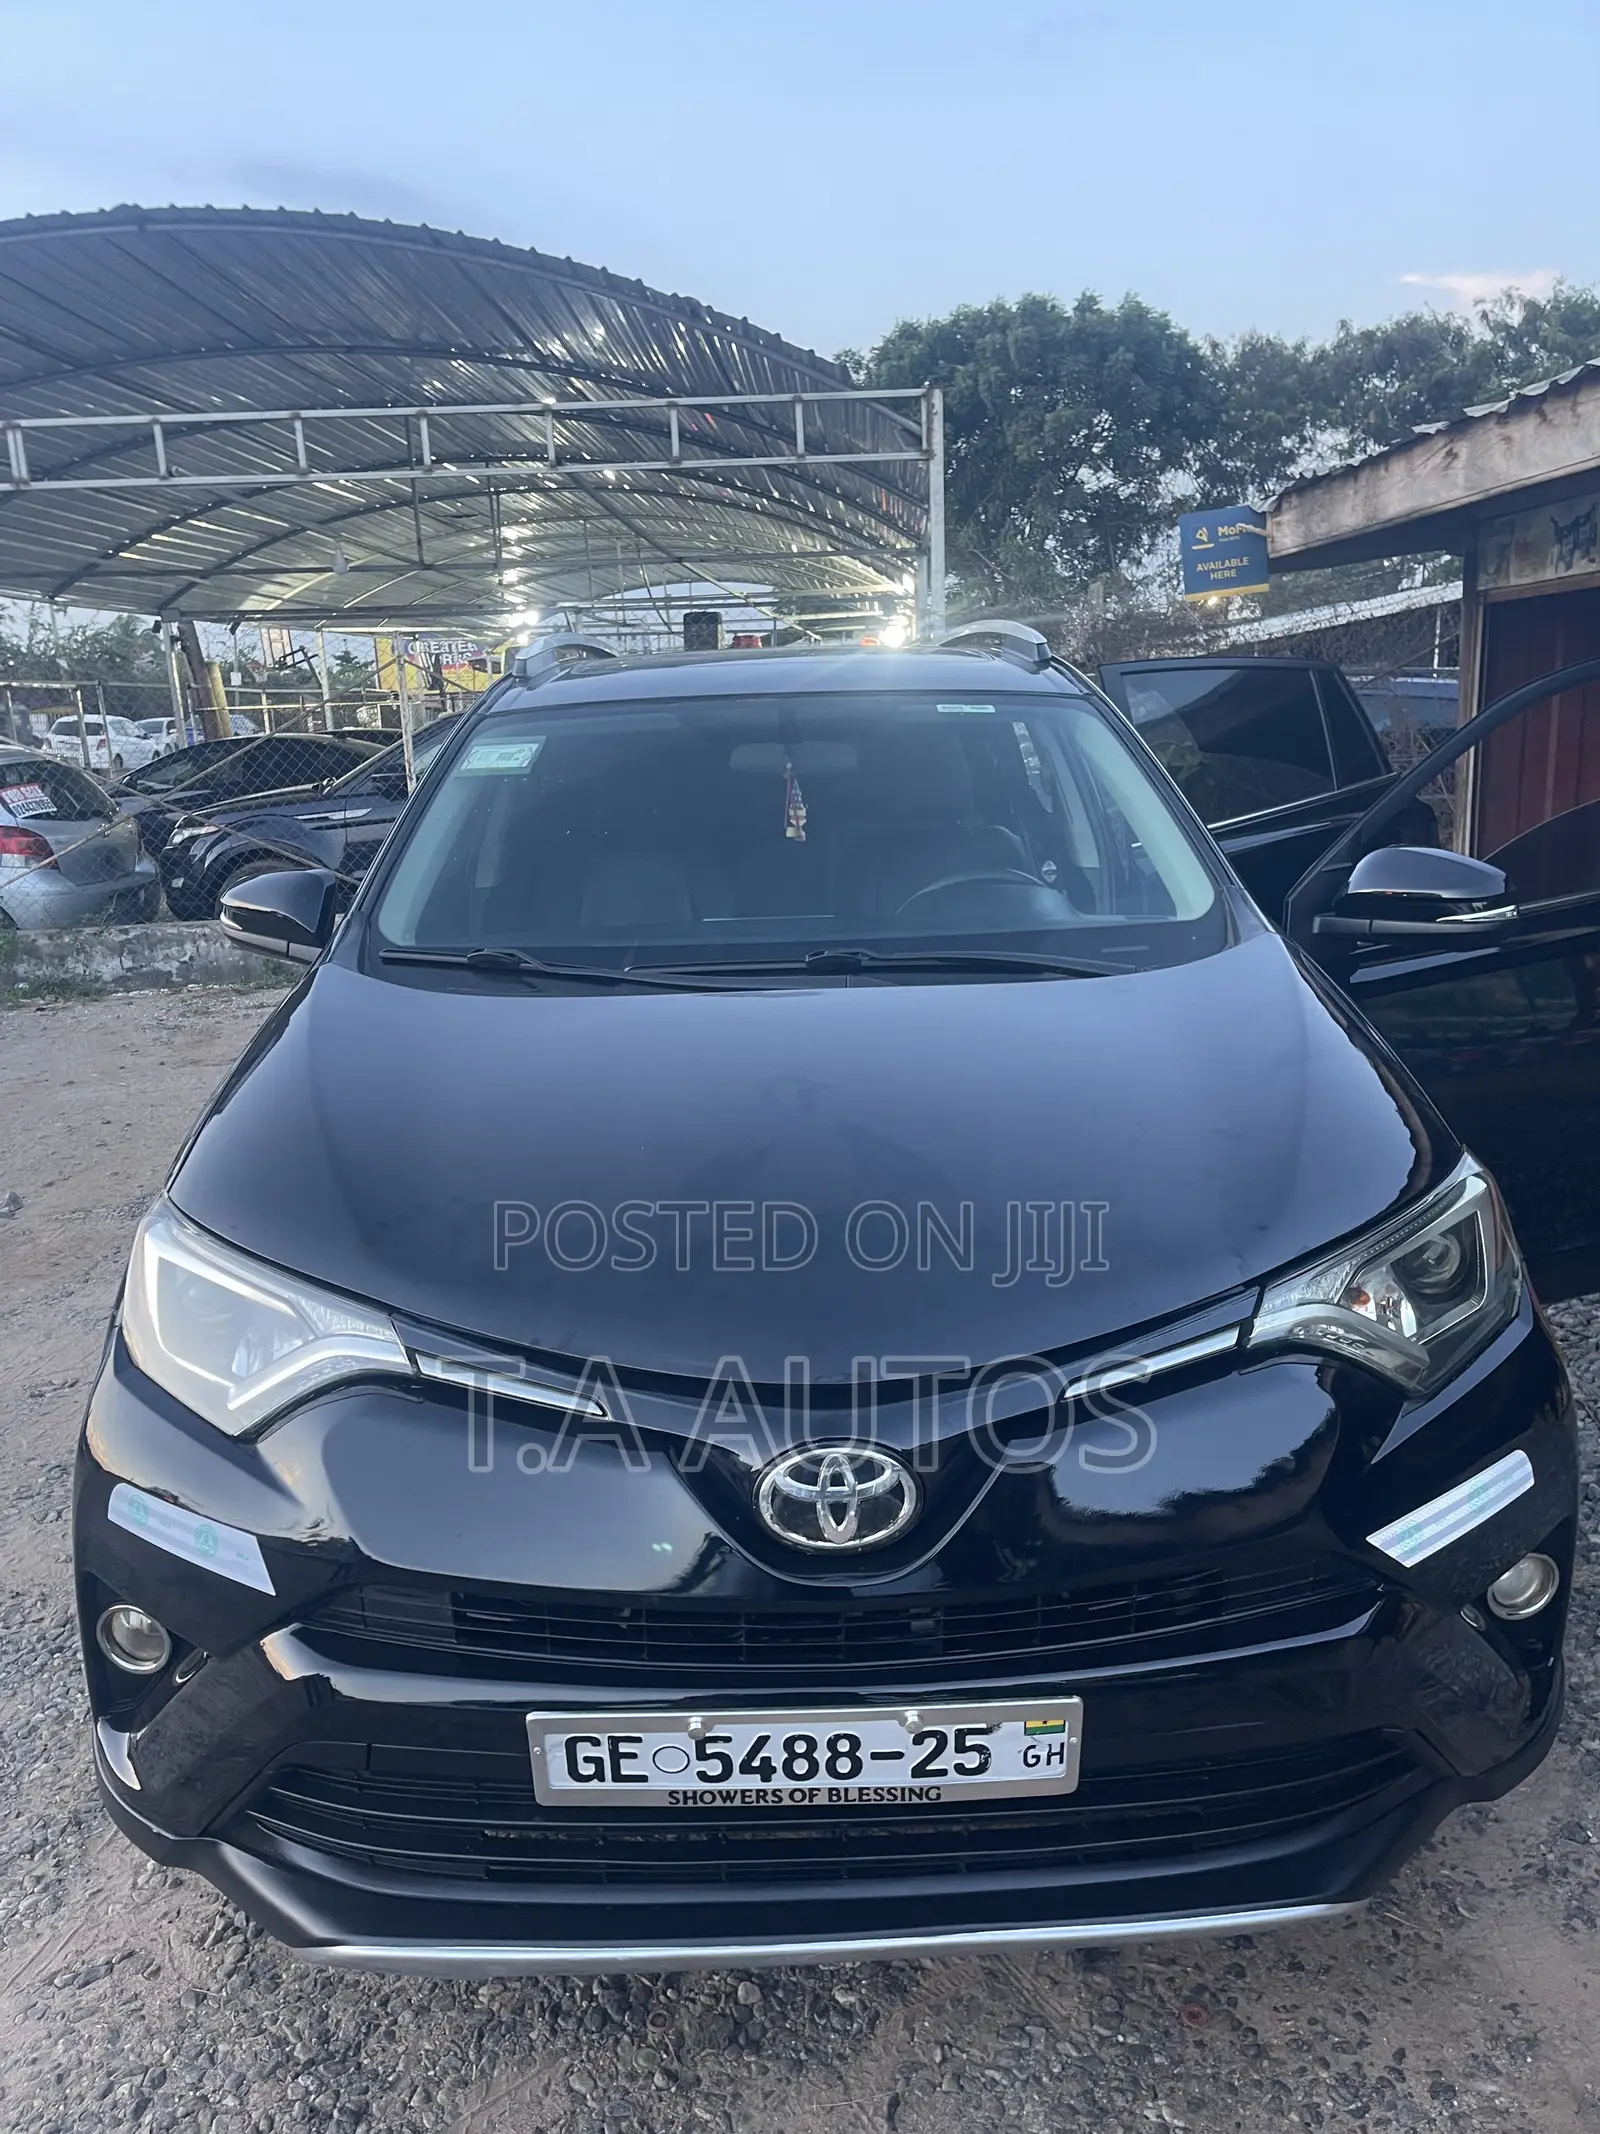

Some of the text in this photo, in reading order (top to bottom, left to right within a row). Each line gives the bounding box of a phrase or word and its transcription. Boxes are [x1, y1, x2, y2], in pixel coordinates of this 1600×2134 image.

[1196, 556, 1250, 572] AVAILABLE
[1210, 569, 1238, 580] HERE
[564, 1726, 995, 1784] GE 5488-25
[1022, 1742, 1065, 1768] GH
[668, 1786, 943, 1806] SHOWERS OF BLESSING
